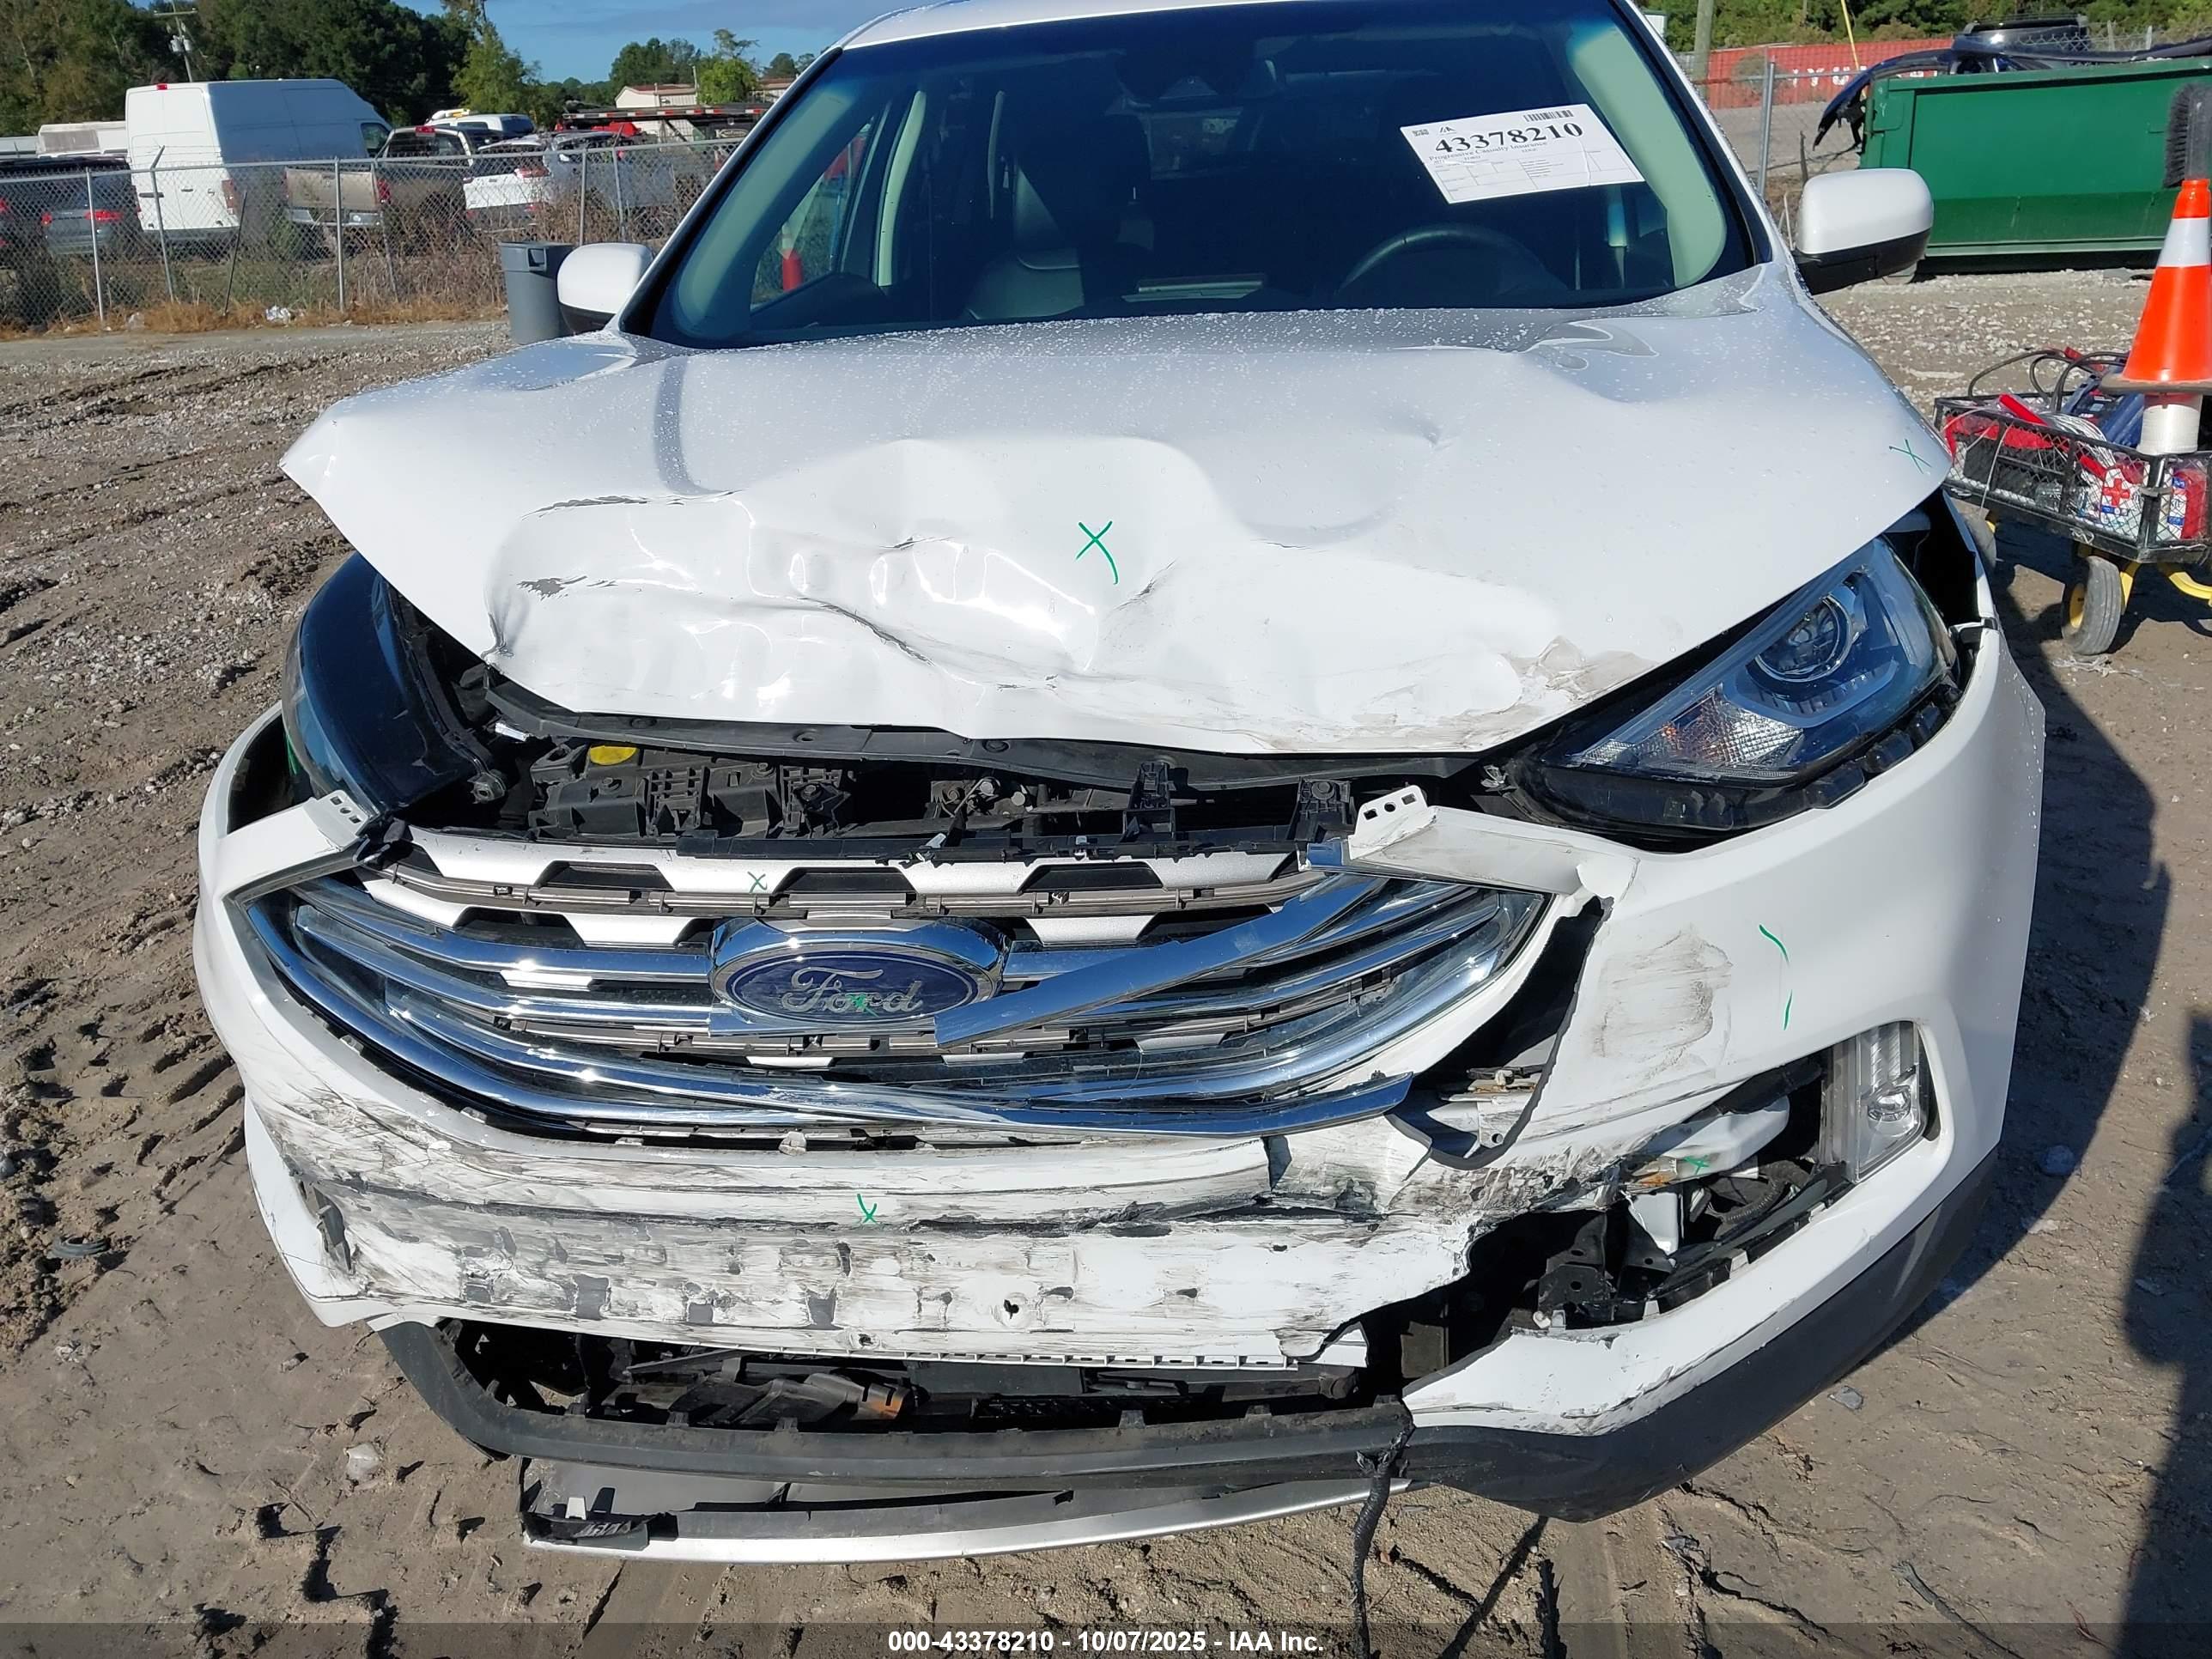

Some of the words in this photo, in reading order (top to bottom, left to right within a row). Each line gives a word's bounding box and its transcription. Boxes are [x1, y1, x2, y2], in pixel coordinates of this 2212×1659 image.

[1429, 150, 1475, 161] Progressive
[1475, 146, 1509, 155] Casualty
[1510, 142, 1547, 150] Insurance
[1435, 122, 1583, 154] 43378210
[781, 967, 923, 1013] Ford
